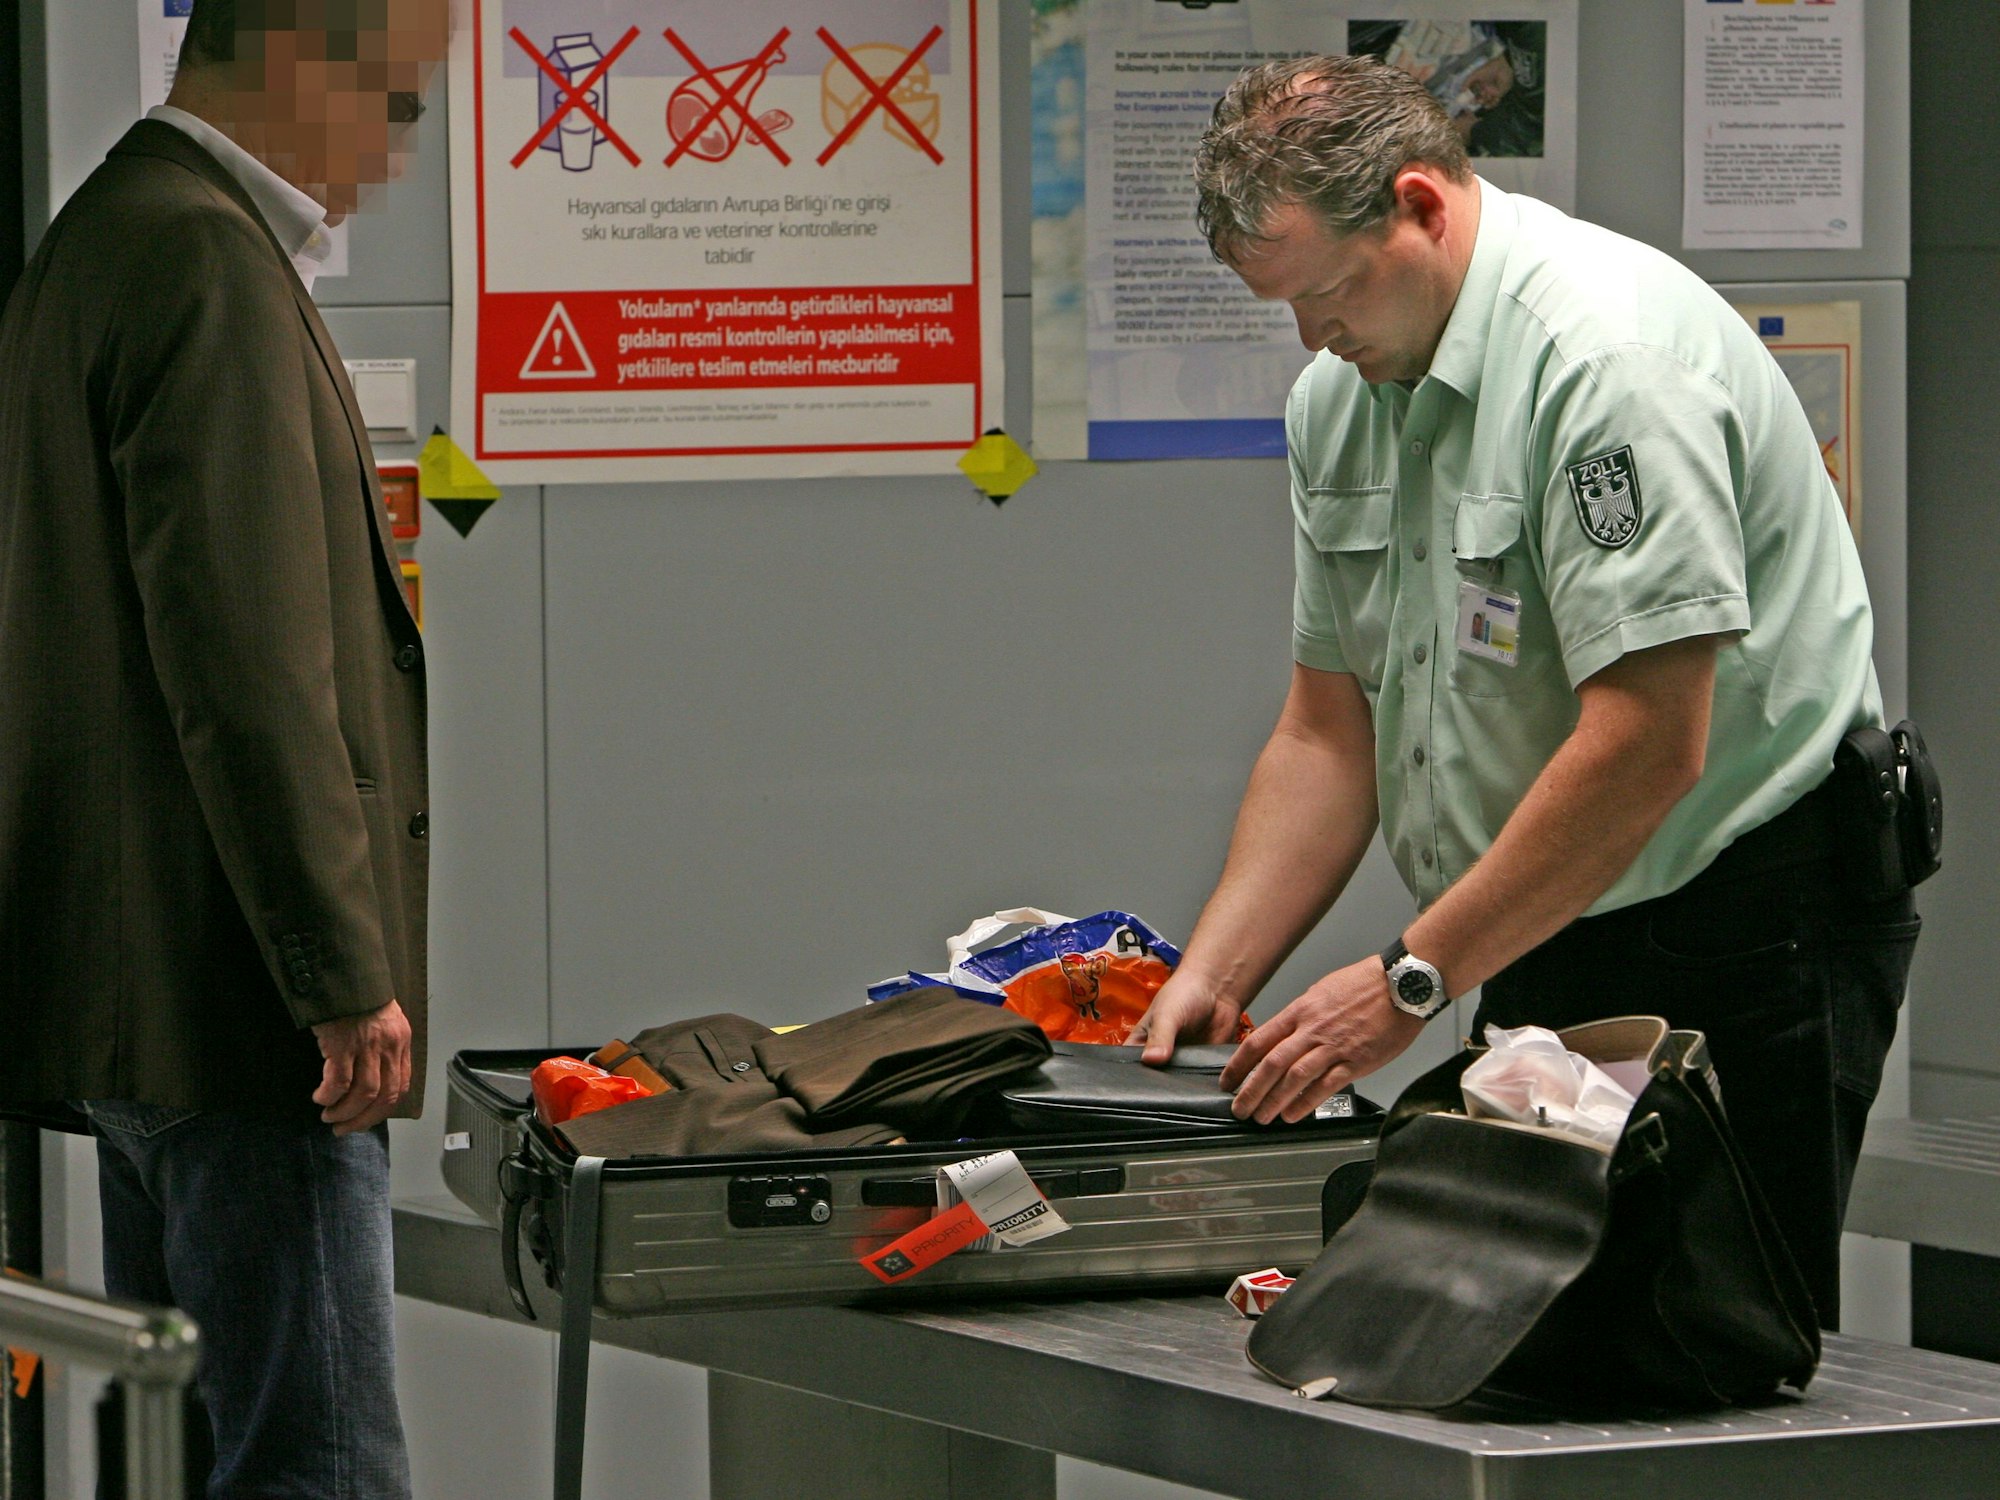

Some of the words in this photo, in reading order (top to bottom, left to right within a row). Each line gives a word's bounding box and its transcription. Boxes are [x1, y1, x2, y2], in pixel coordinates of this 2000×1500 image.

[567, 197, 646, 218] Hayvansal
[650, 196, 718, 217] gıdaların
[722, 196, 780, 215] Avrupa
[856, 194, 891, 215] girişi
[581, 225, 606, 240] sıkı
[610, 224, 679, 239] kurallara
[682, 226, 702, 238] ve
[705, 223, 773, 238] veteriner
[778, 220, 877, 237] kontrollerine
[704, 248, 754, 263] tabidir
[705, 296, 786, 319] yanlarında
[789, 294, 874, 317] getirdikleri
[877, 293, 953, 316] hayvansal
[618, 329, 677, 353] gıdaları
[680, 328, 722, 347] resmi
[725, 326, 816, 347] kontrollerin
[819, 323, 919, 348] yapılabilmesi
[923, 323, 955, 347] için,
[617, 360, 695, 383] yetkililere
[698, 359, 746, 377] teslim
[748, 358, 813, 376] etmeleri
[816, 357, 900, 374] mecburidir
[1578, 456, 1622, 483] ZOLL
[991, 1202, 1047, 1233] PRIORITY
[911, 1215, 977, 1257] PRIORITY
